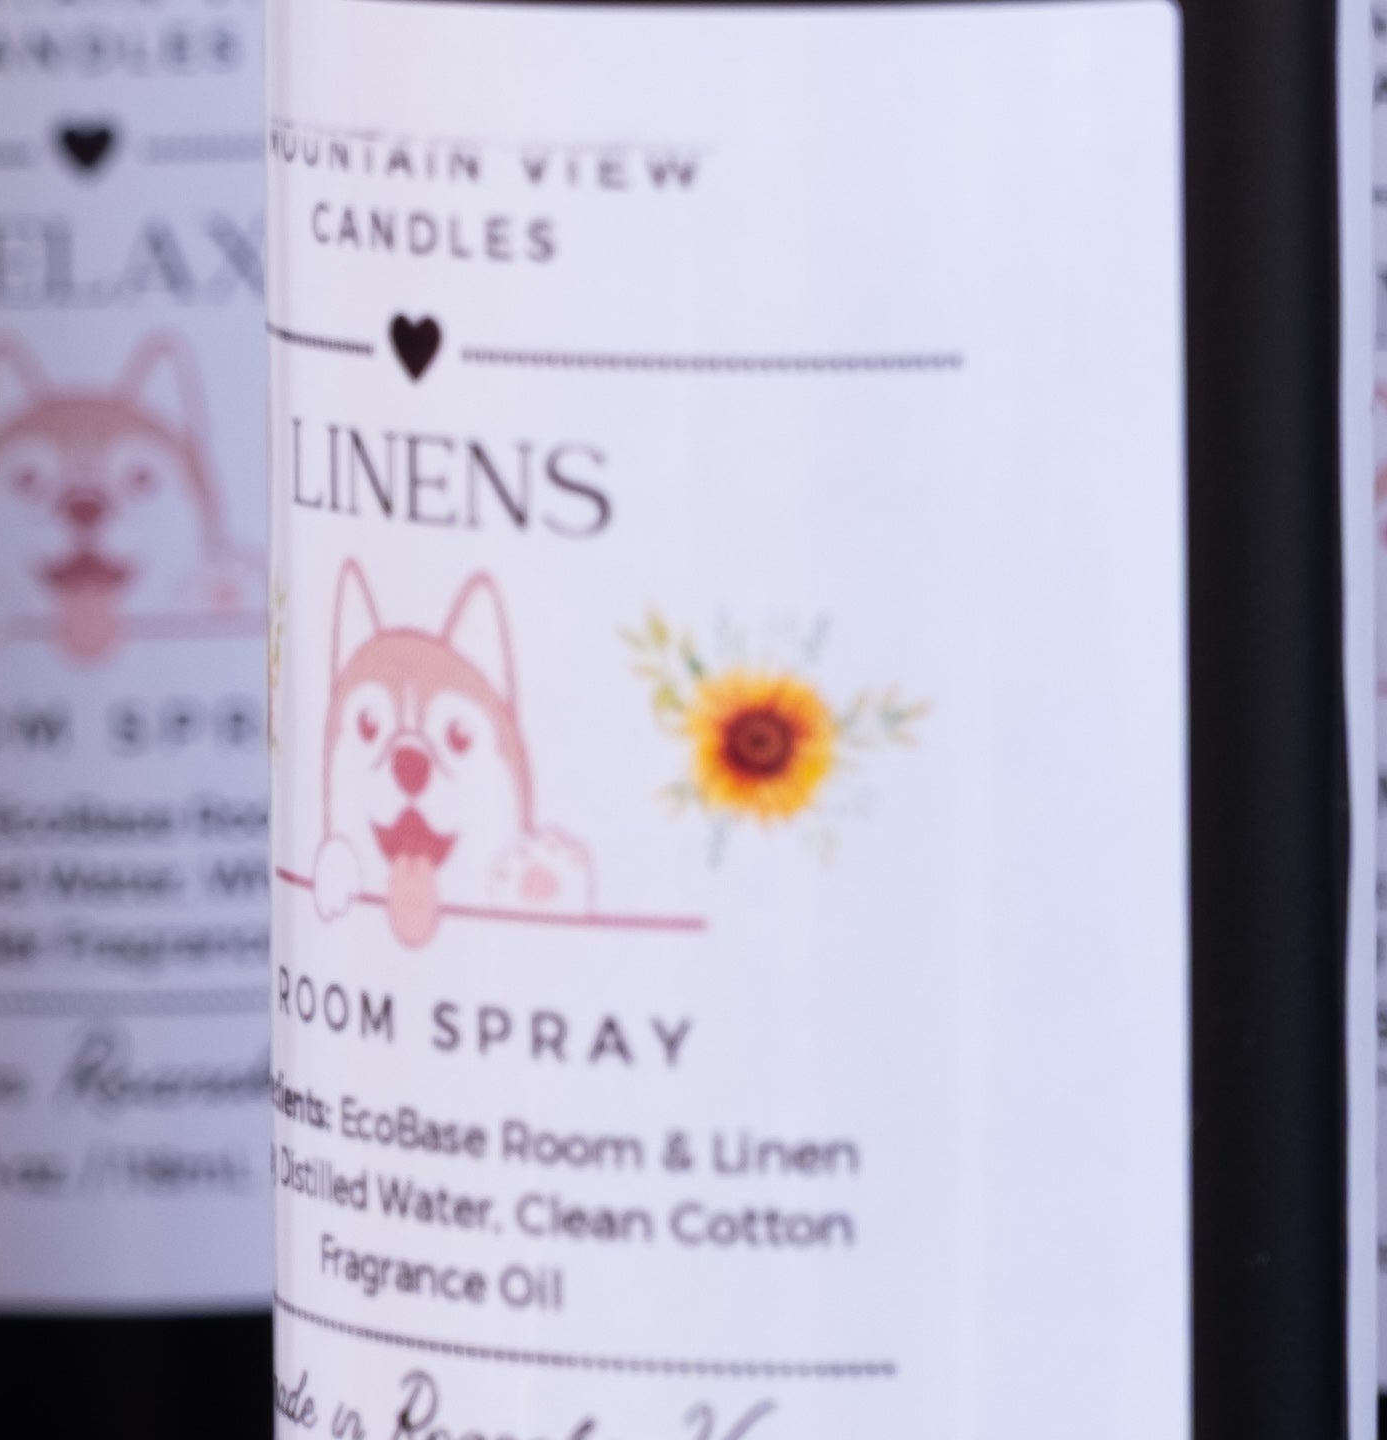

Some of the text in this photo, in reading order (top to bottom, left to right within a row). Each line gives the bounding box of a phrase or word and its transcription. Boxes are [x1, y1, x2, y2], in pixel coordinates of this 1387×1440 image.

[522, 140, 700, 190] VIEW
[312, 200, 557, 263] CANDLES
[288, 417, 615, 539] LINENS
[277, 964, 697, 1066] ROOM SPRAY
[340, 1095, 487, 1157] EcoBase
[500, 1118, 644, 1173] Room
[662, 1131, 695, 1173] &
[712, 1128, 861, 1177] Linen
[280, 1143, 367, 1210] Distilled
[516, 1191, 653, 1246] Clean
[669, 1199, 857, 1249] Cotton
[320, 1232, 565, 1312] Fragrance Oil
